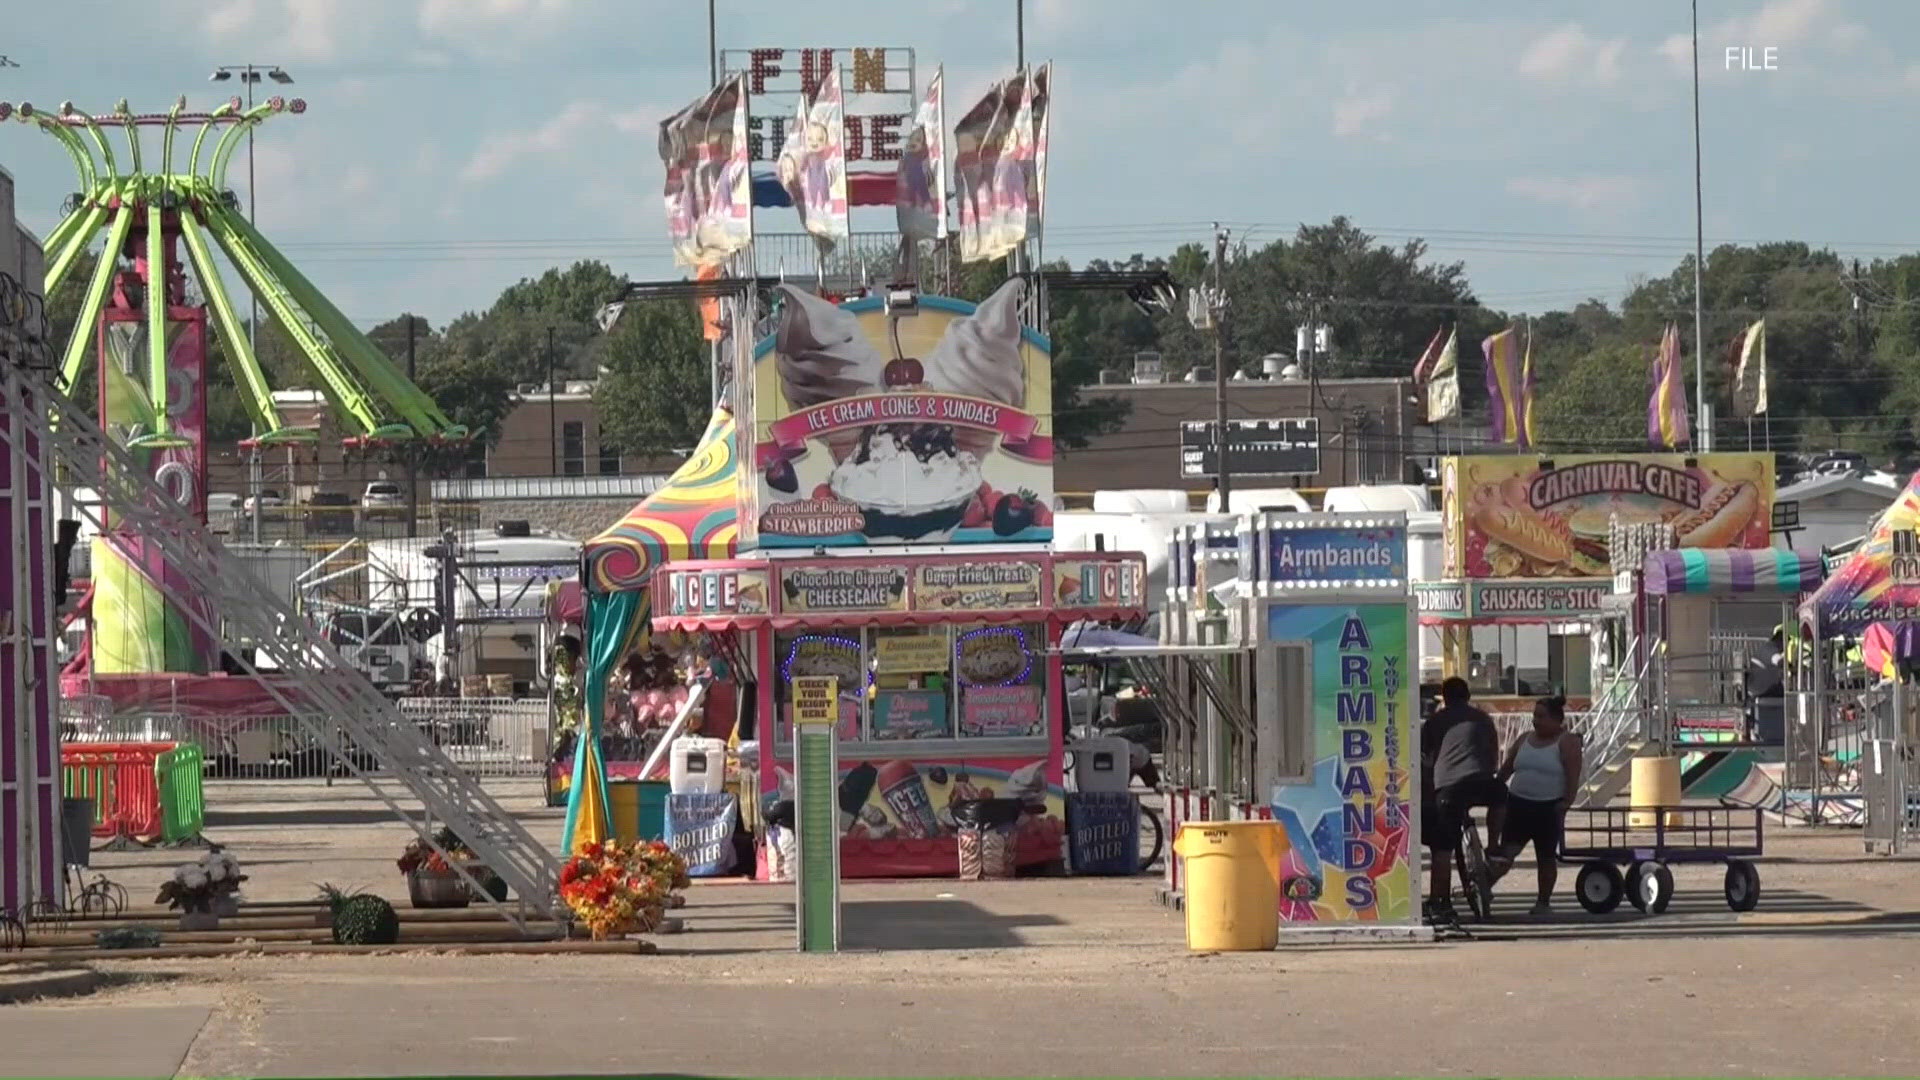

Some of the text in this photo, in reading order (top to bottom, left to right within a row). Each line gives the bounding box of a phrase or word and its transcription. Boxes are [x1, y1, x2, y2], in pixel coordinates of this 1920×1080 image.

[751, 48, 885, 95] FUN
[807, 396, 999, 430] ICE CREAM CONES & SUNDAES
[1530, 462, 1699, 508] CARNIVAL CAFE
[769, 500, 858, 515] Chocolate Dipped
[765, 516, 863, 534] STRAWBERRIES
[1279, 542, 1392, 568] Armbands
[792, 570, 897, 589] Chocolate Dipped
[959, 567, 990, 583] Fried
[991, 567, 1032, 582] Treats
[678, 576, 737, 607] ICEE
[807, 588, 887, 607] CHEESECAKE
[1429, 589, 1462, 610] DRINKS
[1480, 589, 1545, 611] SAUSAGE
[797, 700, 832, 708] HEIGHT
[801, 690, 827, 698] YOUR
[802, 709, 827, 718] HERE
[1336, 616, 1377, 910] ARMBANDS
[672, 821, 728, 850] BOTTLED
[1077, 820, 1130, 846] BOTTLED
[1083, 840, 1122, 863] WATER
